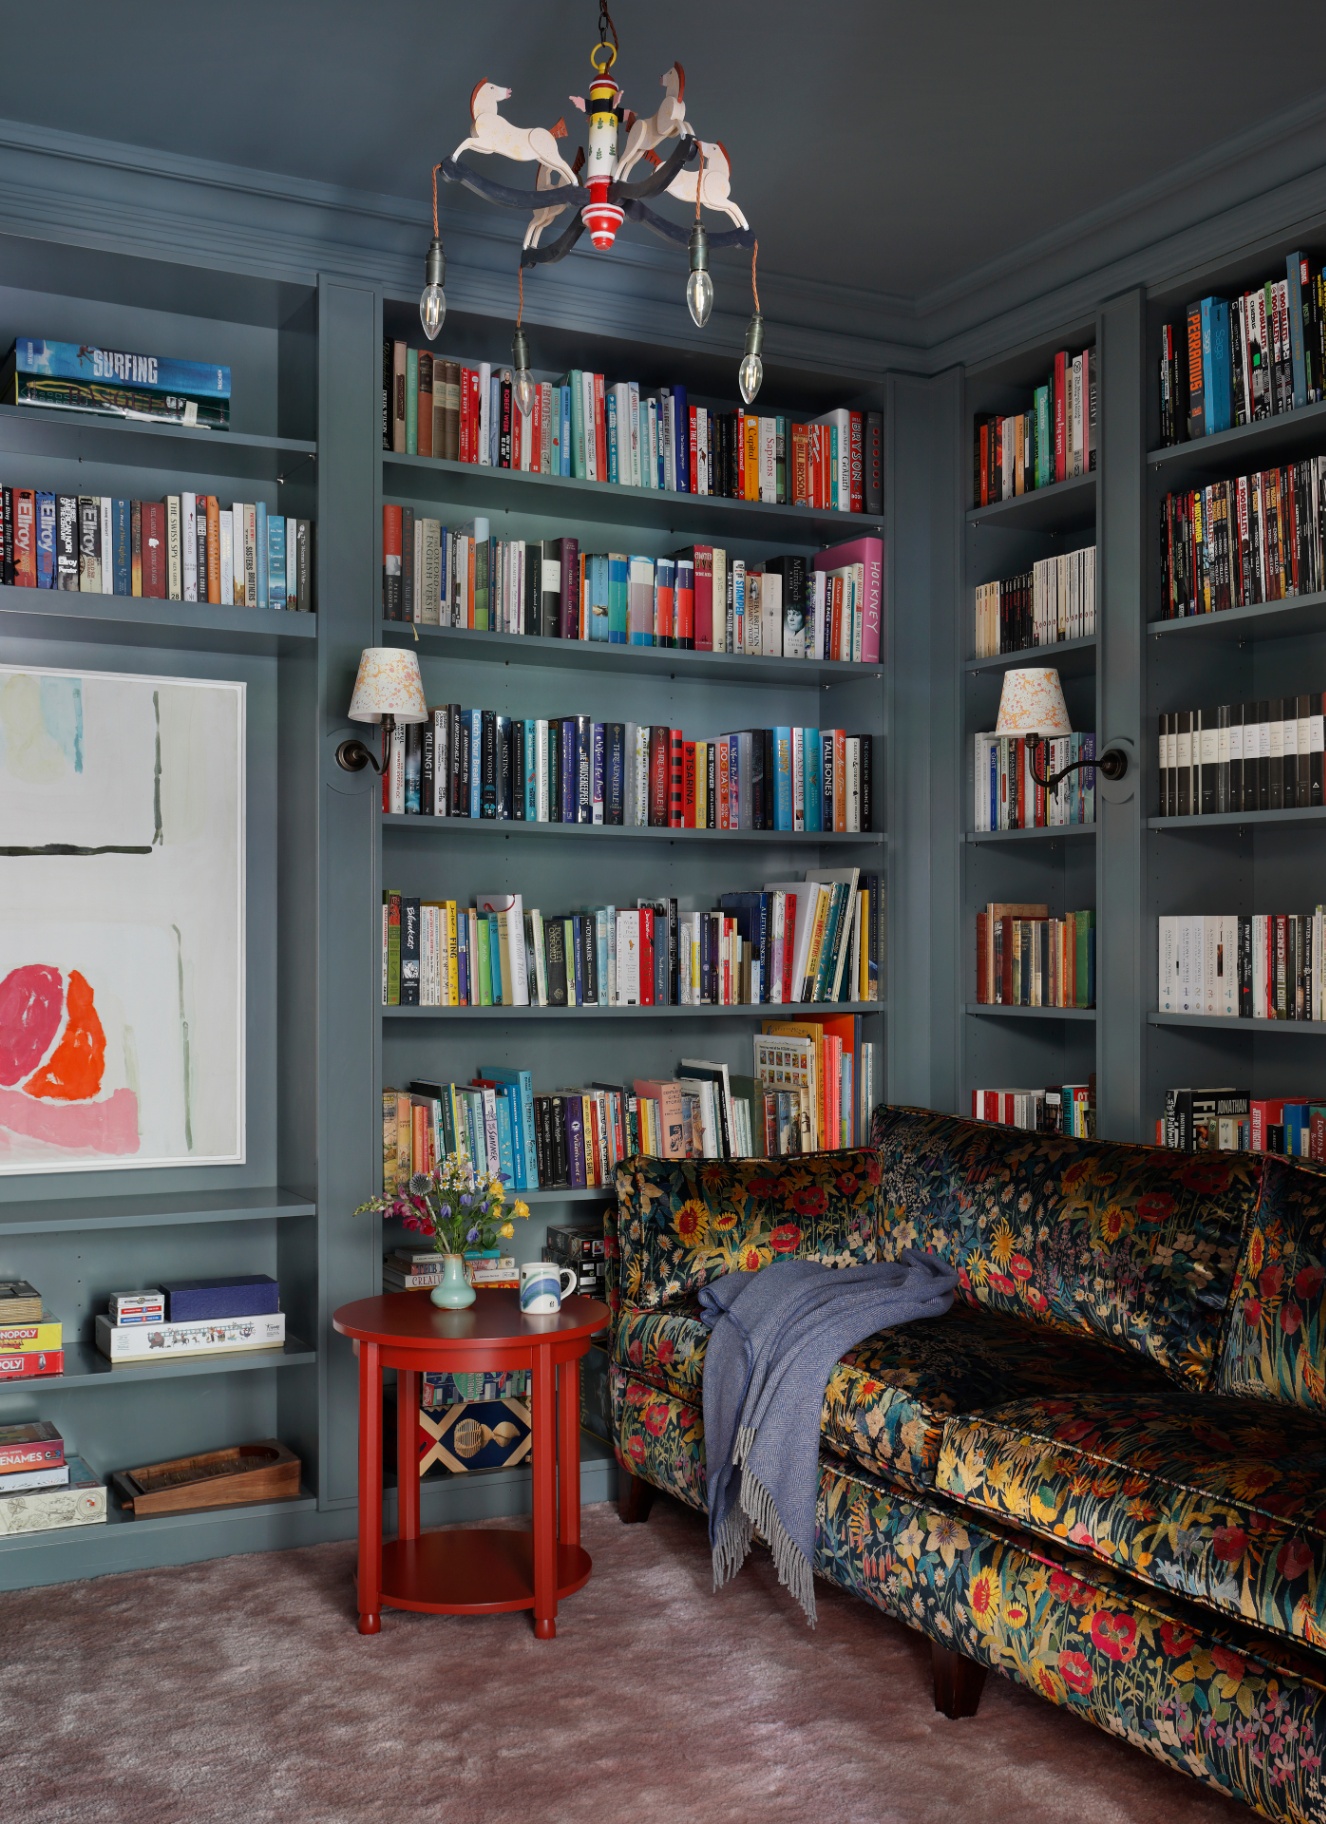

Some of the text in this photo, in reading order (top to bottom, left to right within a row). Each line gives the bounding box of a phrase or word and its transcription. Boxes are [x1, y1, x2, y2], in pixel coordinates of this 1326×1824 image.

[1271, 295, 1280, 344] 100 BULLETS
[1280, 292, 1288, 341] 100 BULLETS
[1188, 314, 1202, 391] PERRAMUS
[1215, 329, 1226, 360] Saga
[93, 349, 158, 384] SURFING
[746, 428, 757, 460] Capital
[1056, 399, 1064, 454] Little Big Rooms
[765, 438, 776, 476] Sapiens
[797, 443, 806, 496] BILL BRYSON
[852, 422, 862, 481] BRYSON
[842, 456, 850, 491] Goliath
[14, 502, 32, 550] Ellroy
[38, 504, 55, 552] Ellroy
[80, 510, 97, 556] Ellroy
[150, 507, 158, 518] NEIL
[170, 502, 178, 559] THE SWISS SPY
[198, 516, 206, 536] LUTHER
[1194, 501, 1202, 543] WATCHMEN
[64, 535, 72, 553] NOIR
[246, 546, 256, 601] SISTERS BROTHERS
[736, 580, 745, 616] STAMPED
[866, 561, 880, 634] HOCKNEY
[424, 732, 432, 780] KILLING IT
[472, 712, 480, 786] Catch Your Breath
[779, 740, 789, 776] HAPPY
[824, 740, 832, 796] TALL BONES
[580, 761, 588, 805] HOUSEKEEPERS
[612, 742, 620, 803] THREADNEEDLE
[686, 758, 694, 805] TSARINA
[406, 906, 416, 950] Blankets
[548, 927, 556, 961] OXFORD
[812, 939, 822, 958] MYTHS
[1277, 964, 1286, 983] NIGHT
[1063, 1092, 1071, 1115] STRANGE
[1253, 1108, 1262, 1129] JEFFREY
[488, 1130, 497, 1160] SUMMER
[0, 1329, 37, 1341] NOPOLY
[466, 1371, 474, 1397] TUMBLIN
[0, 1451, 43, 1466] ENAMES
